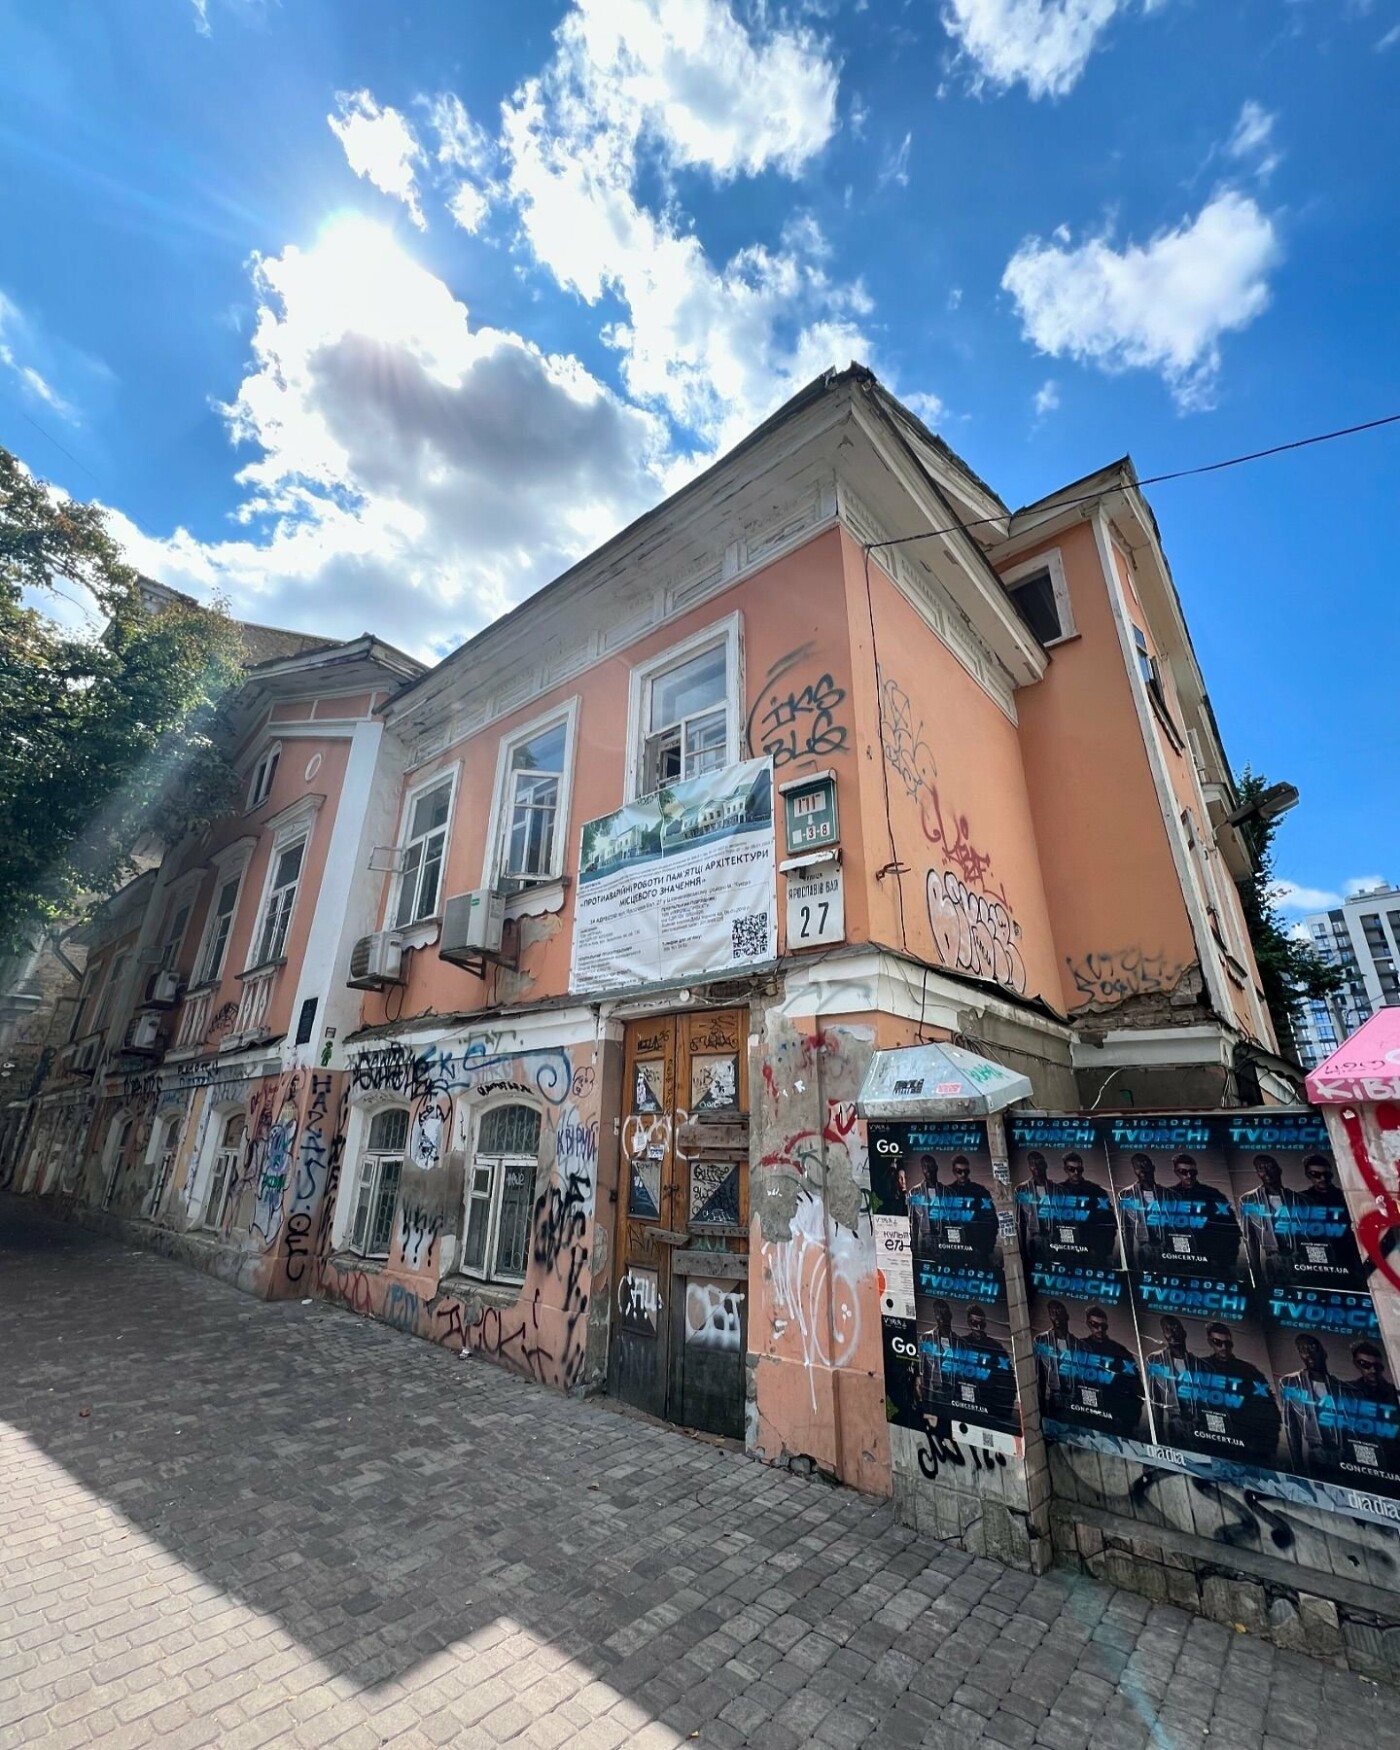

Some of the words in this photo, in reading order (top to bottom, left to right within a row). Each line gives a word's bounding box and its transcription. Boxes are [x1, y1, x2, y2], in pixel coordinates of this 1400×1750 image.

[632, 875, 665, 892] РОБОТИ
[704, 848, 769, 873] АРХІТЕКТУРИ
[618, 889, 659, 908] МІСЦЕВОГО
[788, 882, 824, 899] ЯРОСЛАВІВ
[800, 902, 830, 938] 27
[908, 1133, 981, 1145] TVORCHI
[1012, 1129, 1095, 1141] TVORCHI
[1112, 1129, 1209, 1141] TVORCHI
[910, 1194, 975, 1208] PLANET
[981, 1198, 992, 1210] X
[1016, 1192, 1090, 1207] PLANET
[1097, 1197, 1109, 1209] X
[1120, 1199, 1206, 1213] PLANET
[1215, 1202, 1230, 1215] X
[929, 1209, 975, 1221] SHOW
[1038, 1208, 1090, 1220] SHOW
[1241, 1203, 1345, 1220] PLANET
[1147, 1215, 1208, 1228] SHOW
[1274, 1221, 1347, 1237] SHOW
[1161, 1253, 1208, 1262] CONCERT.UA
[1294, 1264, 1349, 1274] CONCERT.UA
[920, 1274, 999, 1296] TVORCHI
[1031, 1272, 1121, 1297] TVORCHI
[1139, 1285, 1247, 1311] TVORCHI
[920, 1341, 991, 1365] PLANET
[998, 1356, 1012, 1370] X
[1034, 1343, 1114, 1369] PLANET
[1123, 1359, 1137, 1374] X
[941, 1361, 991, 1381] SHOW
[1059, 1363, 1116, 1384] SHOW
[1147, 1363, 1243, 1391] PLANET
[1253, 1380, 1270, 1397] X
[1178, 1386, 1244, 1409] SHOW
[1283, 1385, 1398, 1420] PLANET
[1318, 1411, 1400, 1440] SHOW
[1194, 1430, 1245, 1448] CONCERT.UA
[1340, 1462, 1400, 1482] CONCERT.UA
